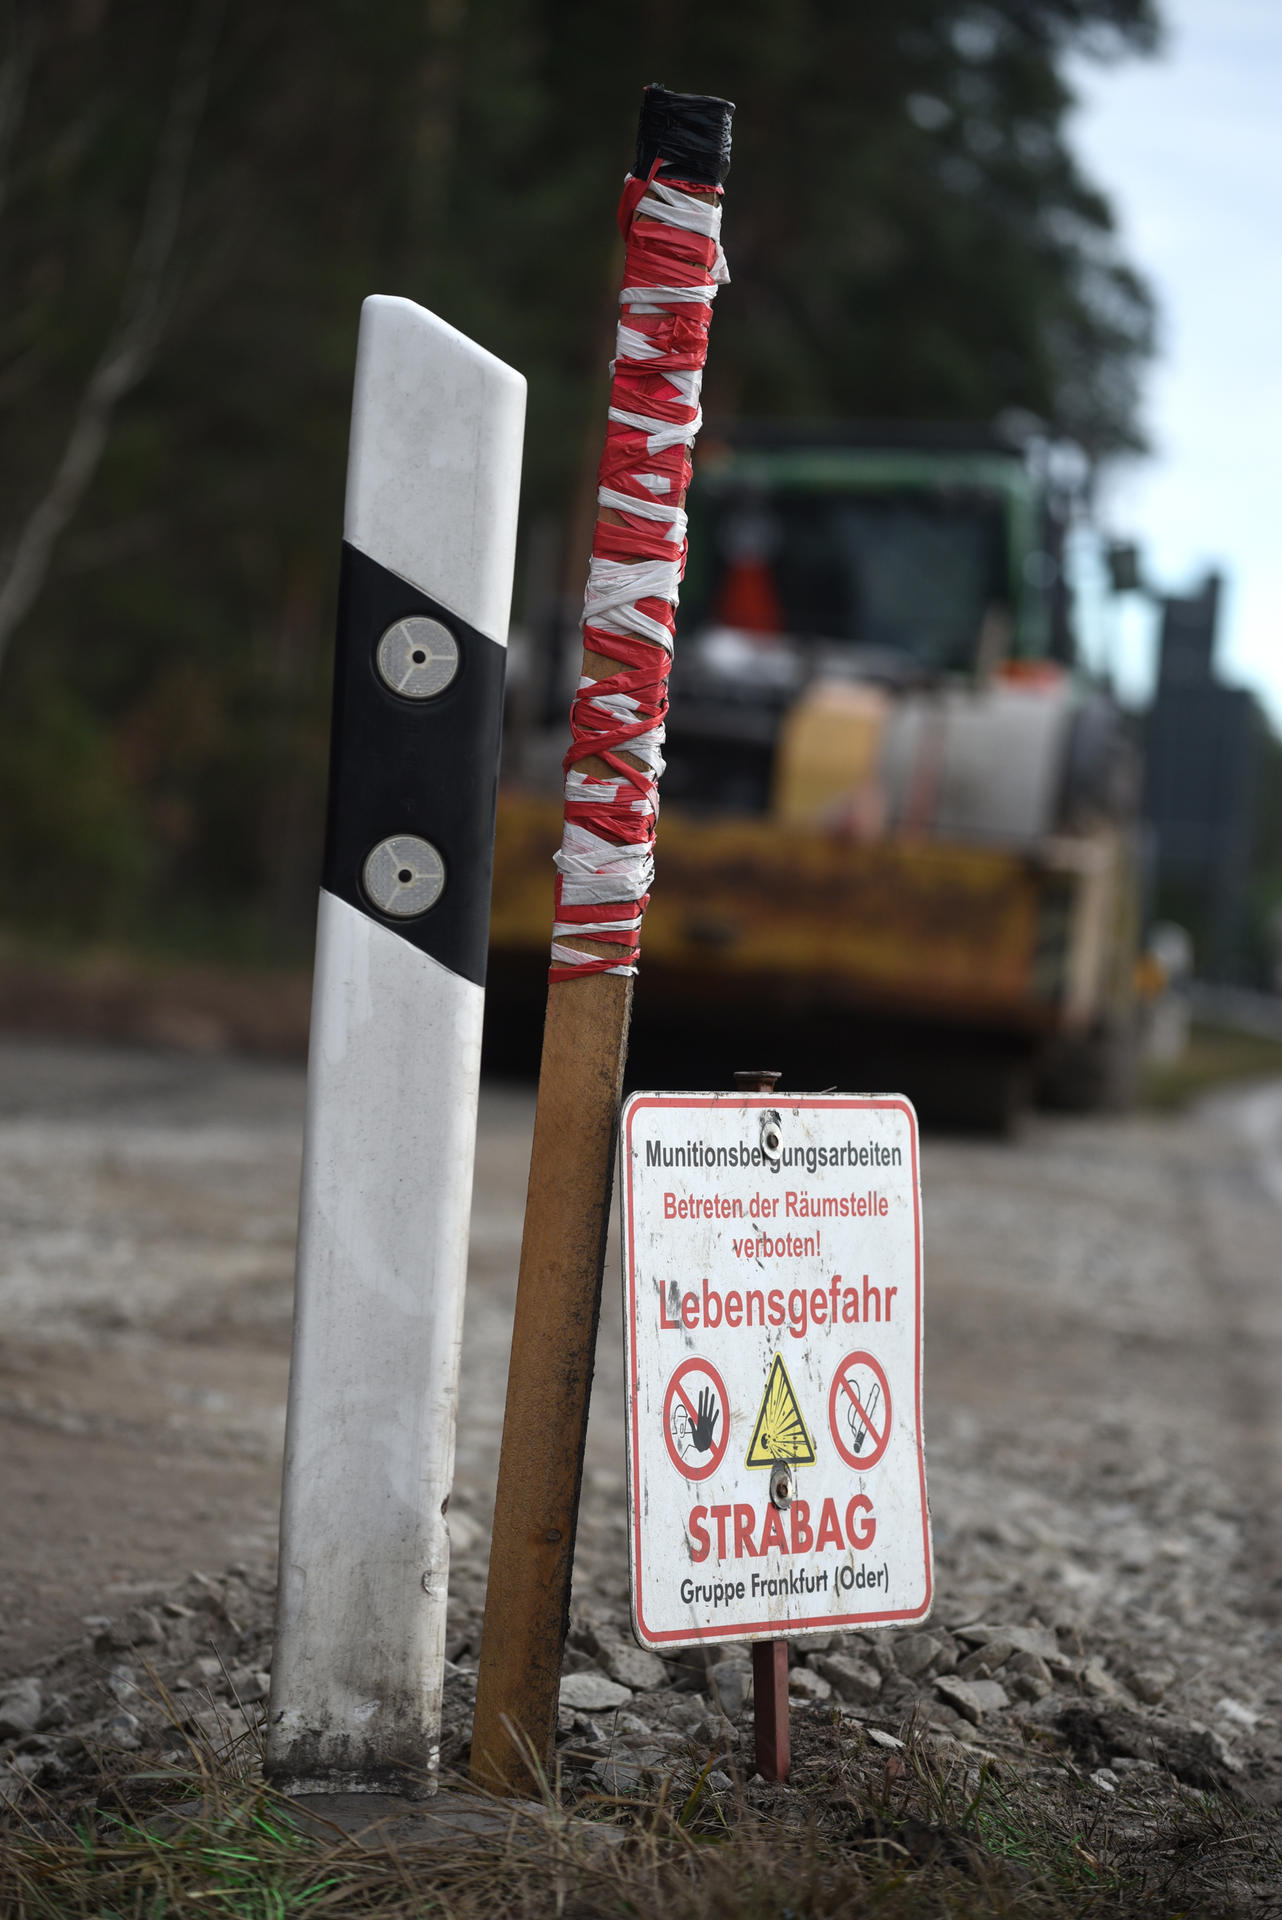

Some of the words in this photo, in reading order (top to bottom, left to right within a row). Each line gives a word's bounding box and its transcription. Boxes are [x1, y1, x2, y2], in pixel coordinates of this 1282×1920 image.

[663, 1191, 743, 1219] Betreten
[749, 1191, 779, 1218] der
[785, 1190, 889, 1218] Räumstelle
[732, 1230, 821, 1259] verboten!
[659, 1274, 898, 1339] Lebensgefahr
[688, 1493, 877, 1563] STRABAG
[680, 1577, 745, 1608] Gruppe
[751, 1568, 828, 1598] Frankfurt
[834, 1562, 890, 1598] (Oder)
